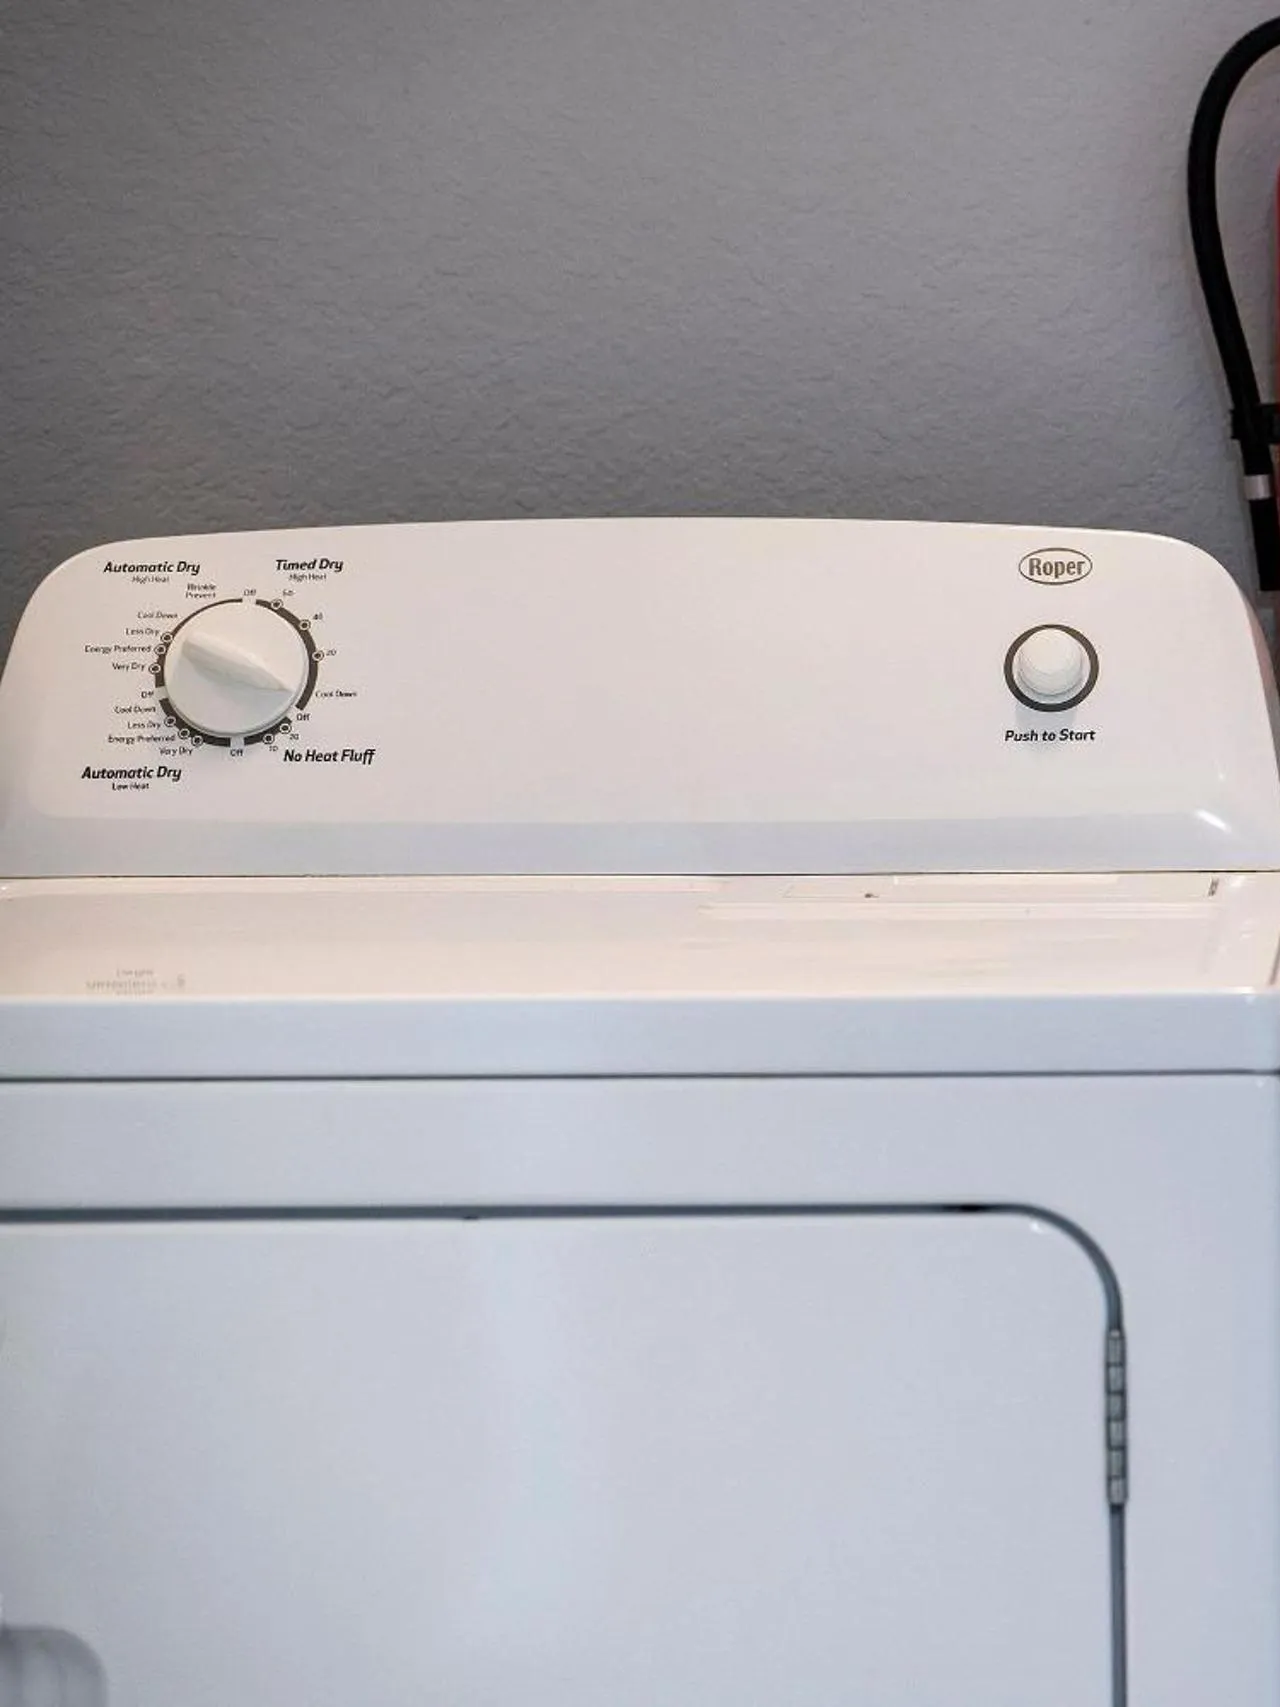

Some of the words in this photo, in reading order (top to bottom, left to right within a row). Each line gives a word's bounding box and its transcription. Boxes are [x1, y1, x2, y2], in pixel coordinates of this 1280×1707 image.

[103, 561, 174, 573] Automatic
[176, 561, 201, 576] Dry
[276, 559, 318, 571] Timed
[319, 558, 344, 573] Dry
[1028, 557, 1086, 579] Roper
[289, 574, 308, 582] High
[125, 628, 144, 636] Less
[84, 645, 112, 654] Energy
[114, 645, 152, 653] Preferred
[112, 662, 130, 672] Very
[296, 712, 311, 721] Off
[127, 721, 146, 730] Less
[1004, 729, 1039, 742] Push
[1042, 730, 1056, 742] to
[1059, 728, 1097, 742] Start
[230, 749, 245, 758] Off
[283, 749, 303, 762] No
[305, 749, 339, 762] Heat
[341, 748, 376, 765] Fluff
[81, 766, 155, 779] Automatic
[156, 766, 182, 783] Dry
